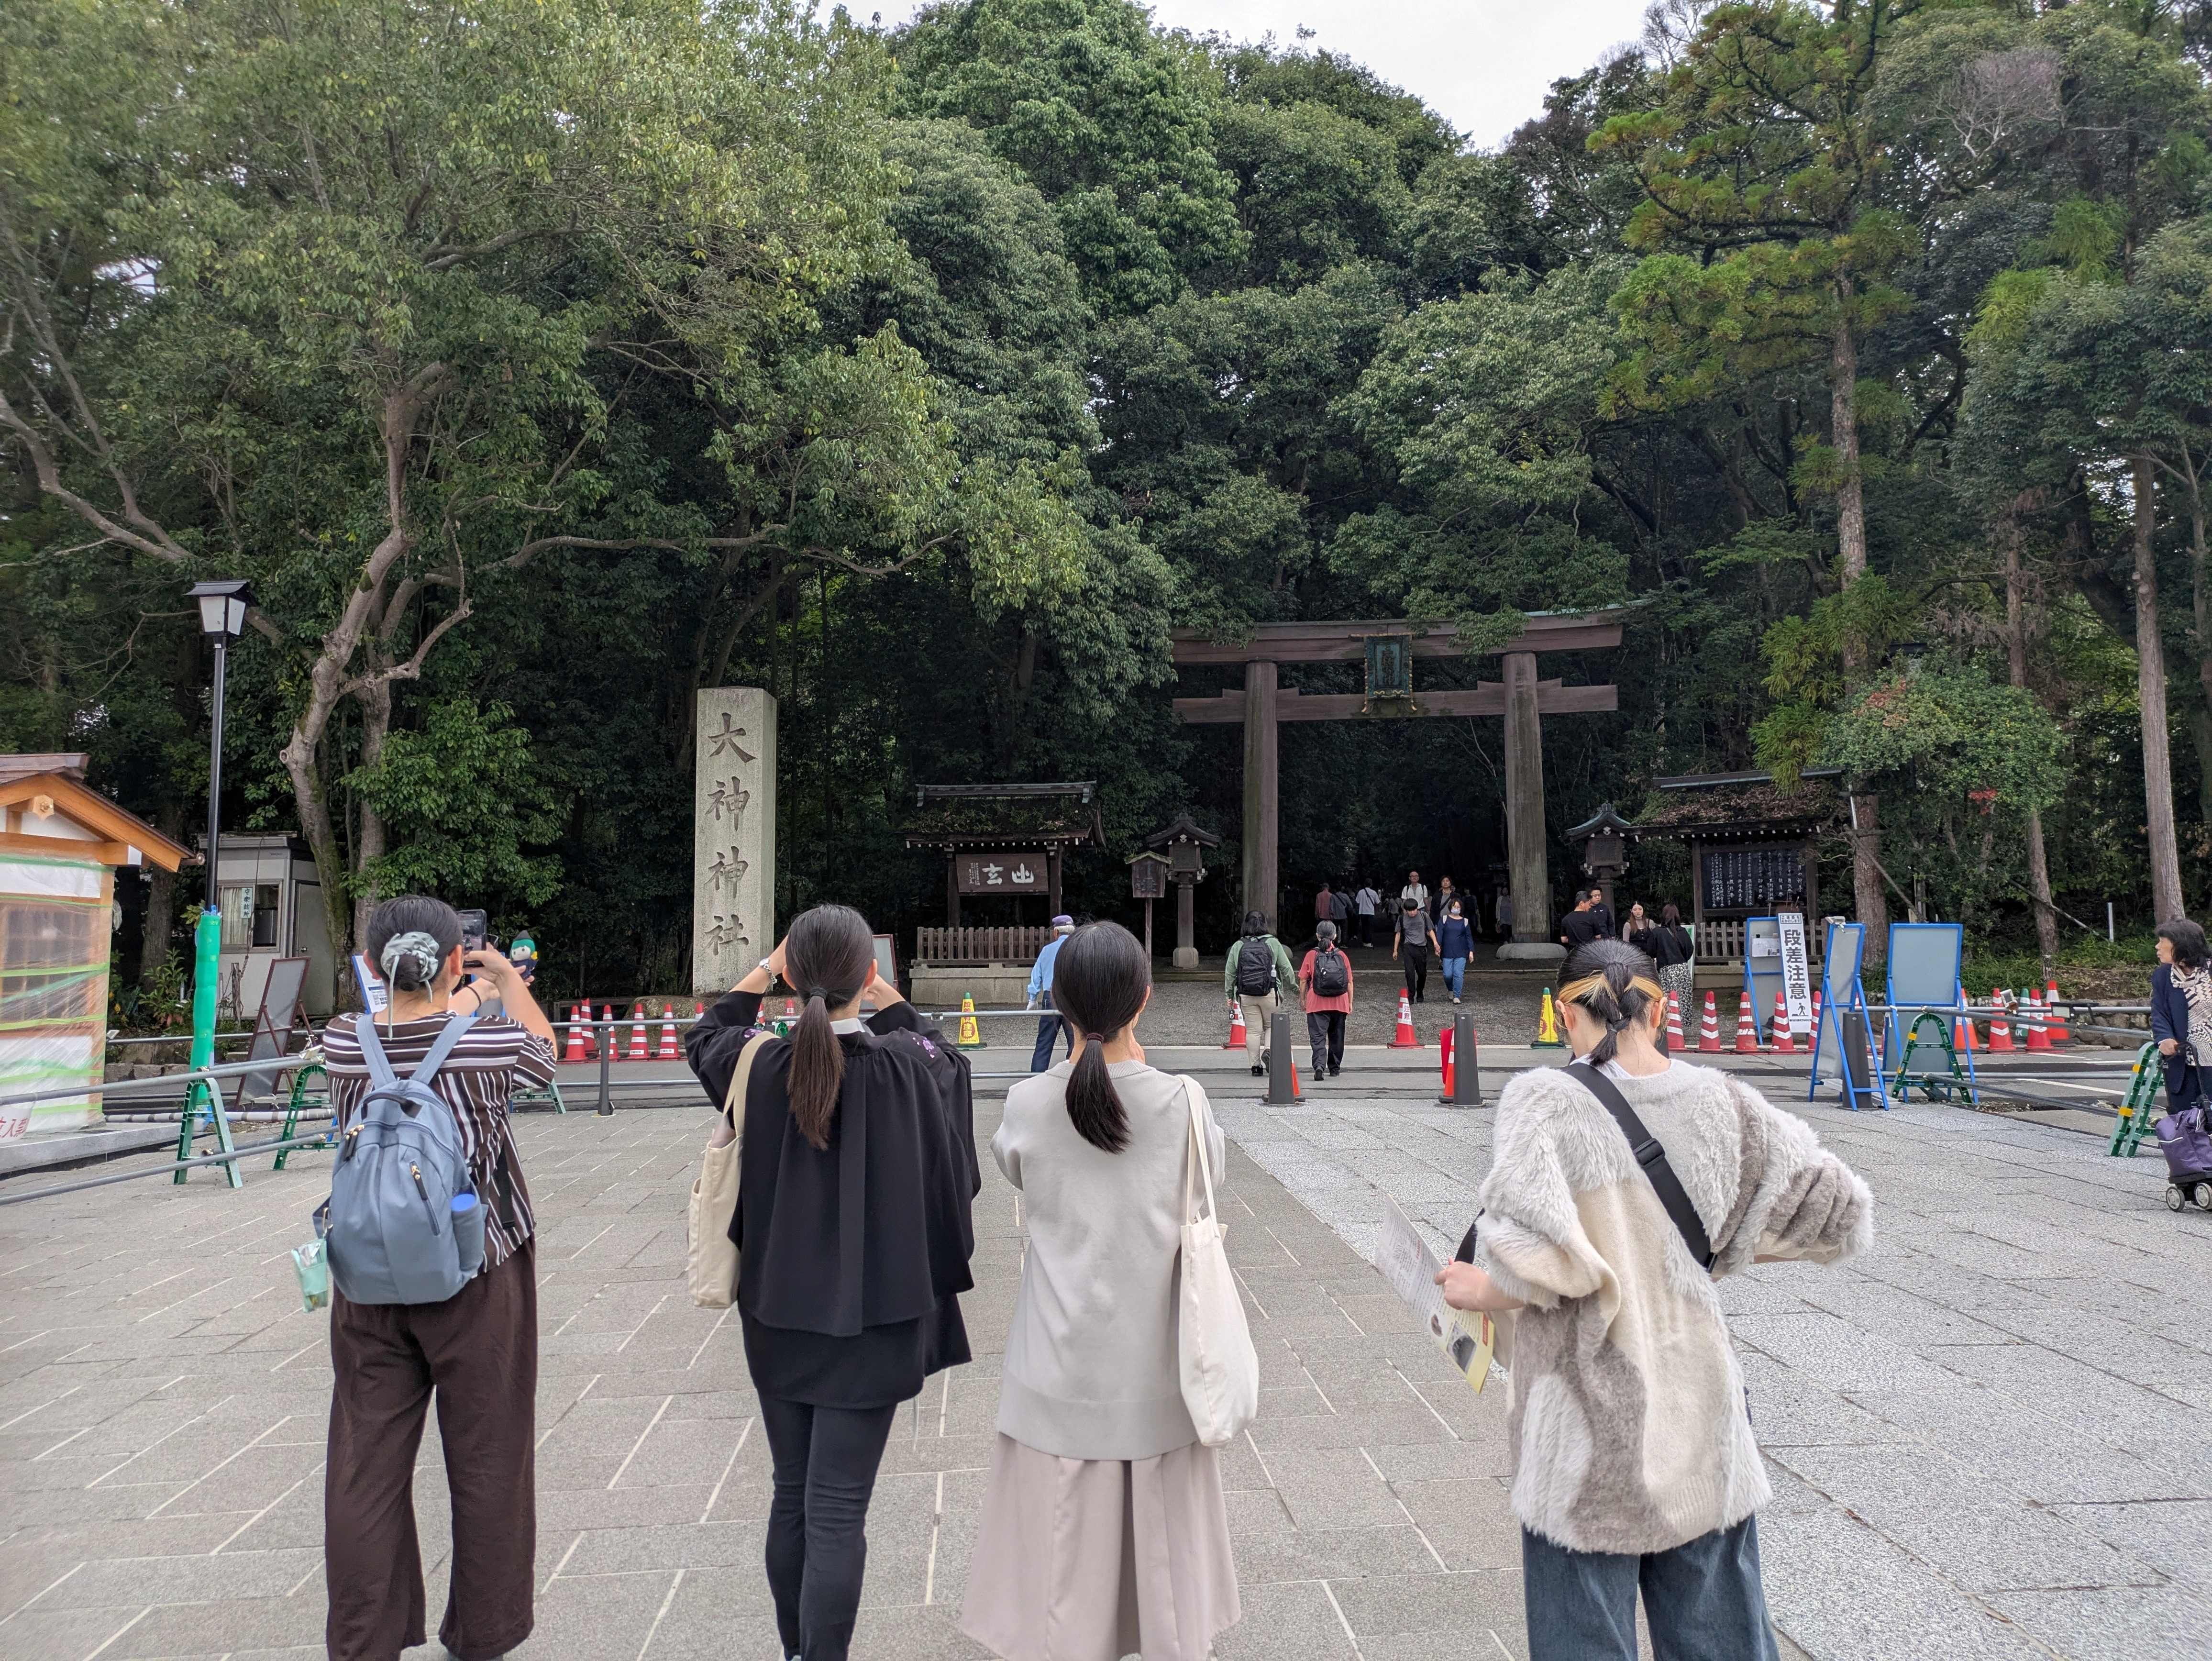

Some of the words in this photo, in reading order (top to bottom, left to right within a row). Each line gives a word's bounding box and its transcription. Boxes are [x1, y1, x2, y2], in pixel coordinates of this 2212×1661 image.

[705, 712, 757, 956] 大神神社
[1784, 929, 1806, 999] 段差注意
